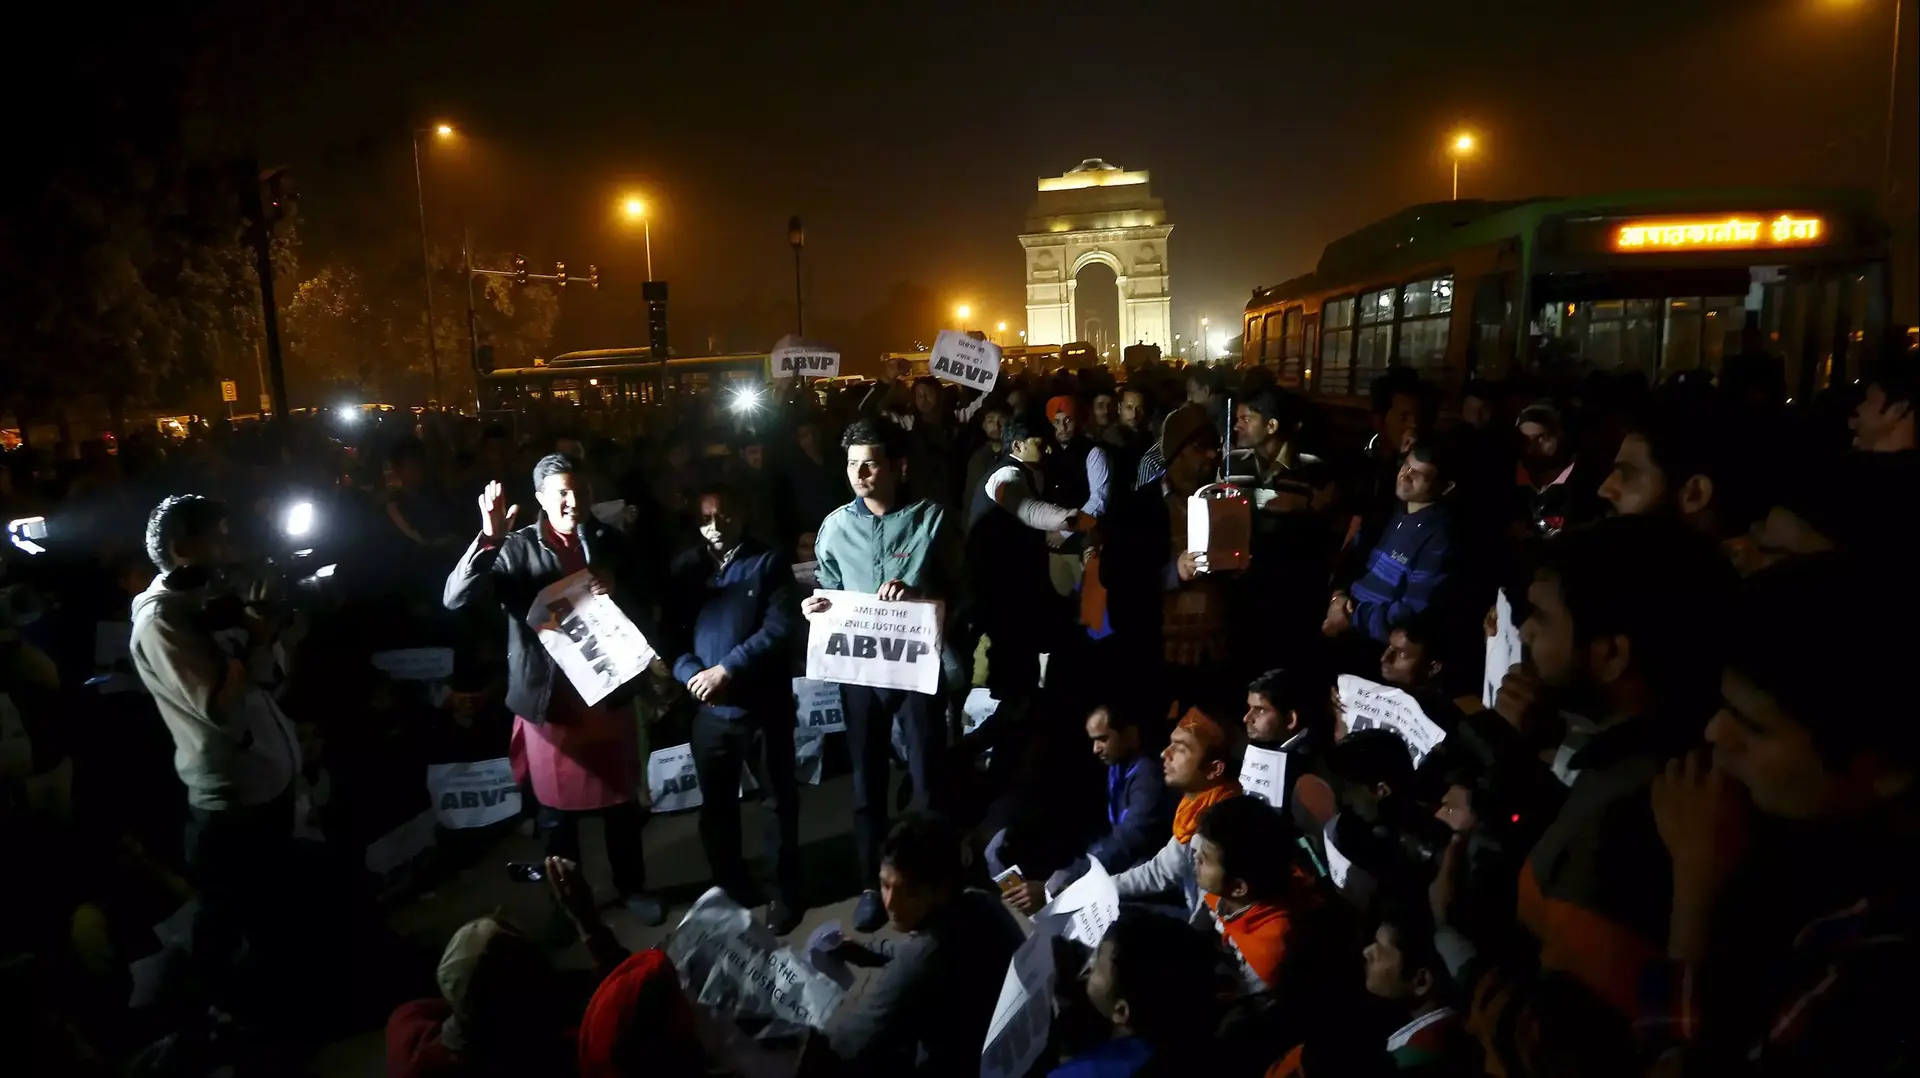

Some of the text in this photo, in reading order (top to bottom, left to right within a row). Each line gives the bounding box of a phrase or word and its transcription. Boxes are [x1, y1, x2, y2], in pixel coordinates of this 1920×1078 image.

[1618, 214, 1819, 246] आपातकालीन सेवा
[780, 356, 834, 371] ABVP
[934, 355, 994, 384] ABVP
[853, 605, 908, 619] AMEND THE
[546, 597, 619, 677] ABVP
[871, 620, 908, 633] JUSTICE
[825, 632, 930, 664] ABVP
[809, 709, 842, 726] AB
[663, 774, 698, 795] AB
[778, 962, 797, 984] THE
[749, 965, 788, 1005] JUSTICE
